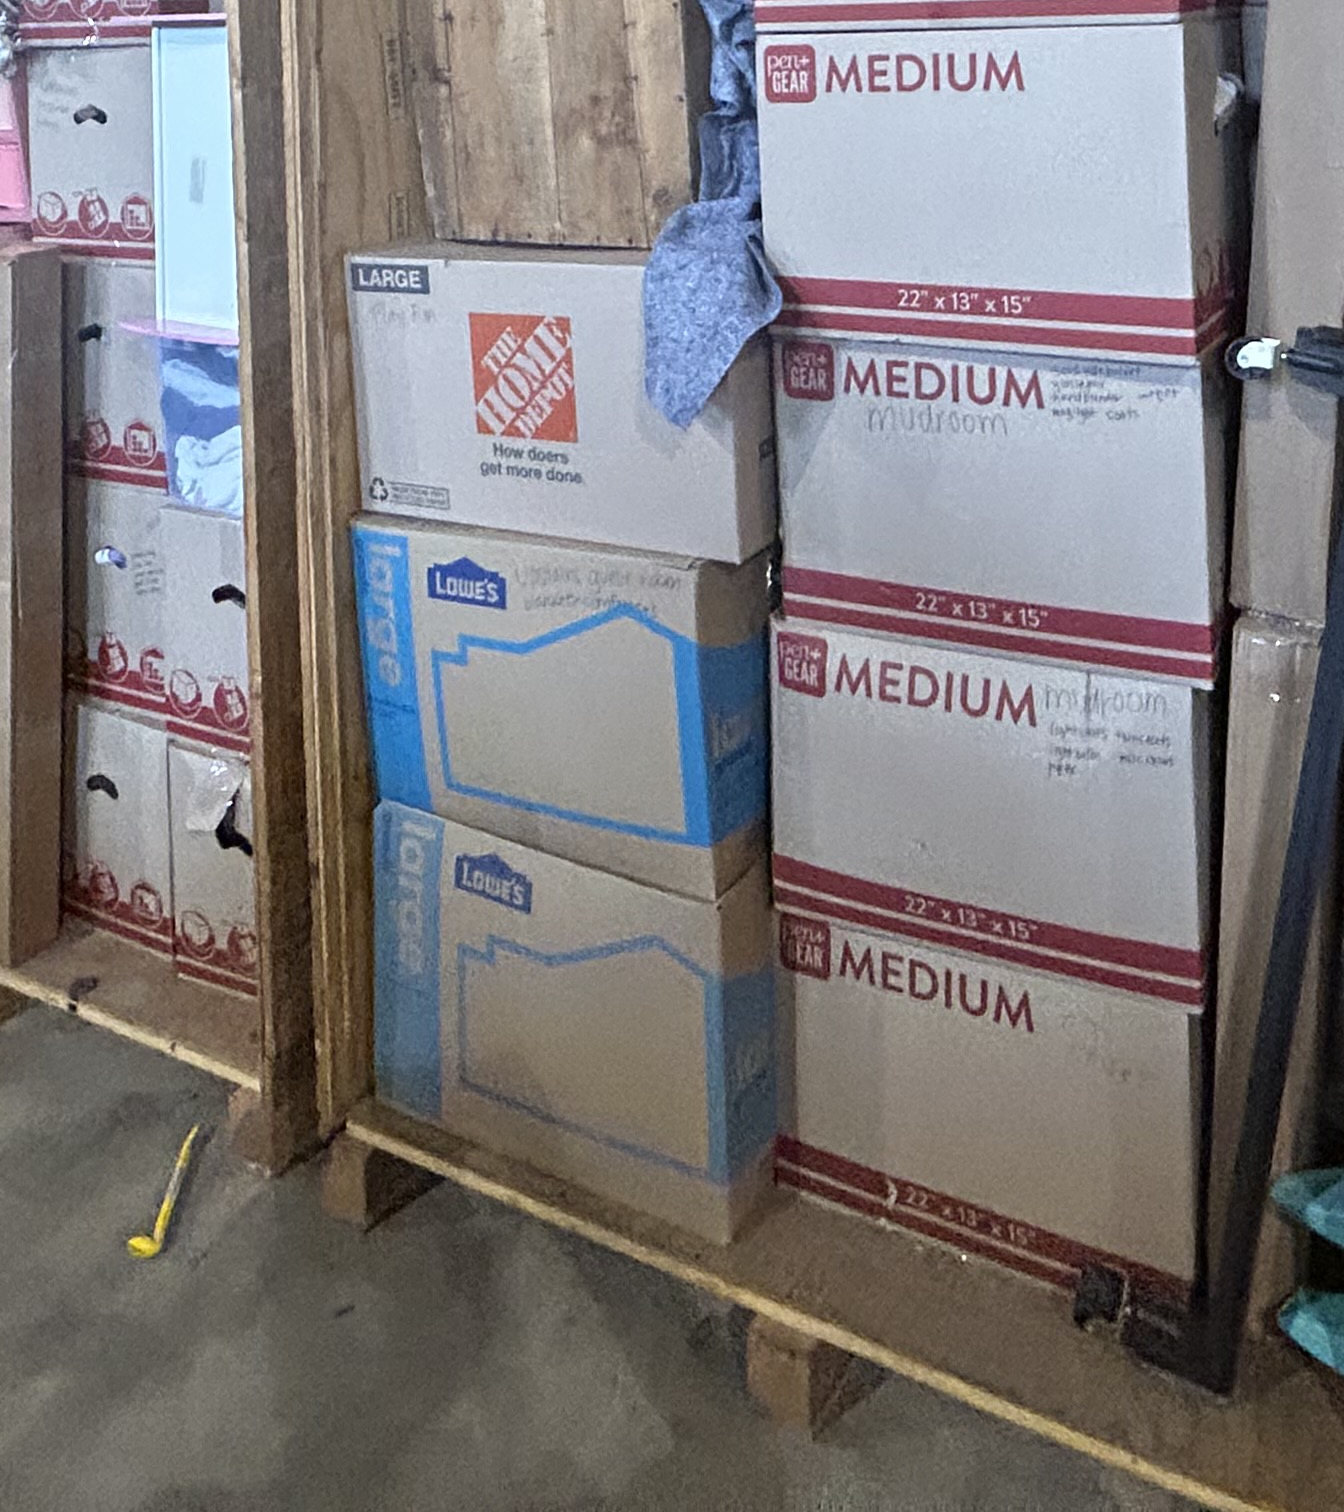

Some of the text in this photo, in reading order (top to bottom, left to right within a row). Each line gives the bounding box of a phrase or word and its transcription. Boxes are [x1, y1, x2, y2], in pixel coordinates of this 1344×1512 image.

[771, 70, 810, 94] GEAR
[824, 49, 1025, 94] MEDIUM
[357, 268, 422, 289] LARGE
[897, 288, 1032, 314] 22" x 13" x 15"
[481, 325, 523, 376] THE
[476, 316, 572, 436] HOME
[789, 366, 827, 391] GEAR
[843, 355, 1045, 410] MEDIUM
[514, 361, 574, 439] DEPOT
[479, 460, 502, 477] get
[506, 464, 543, 481] more
[492, 442, 570, 465] How doers
[915, 591, 1049, 628] 22" x 13" x 15"
[783, 657, 819, 688] GEAR
[834, 652, 1037, 728] MEDIUM
[941, 908, 952, 922] x
[991, 919, 1004, 933] x
[839, 939, 1035, 1033] MEDIUM
